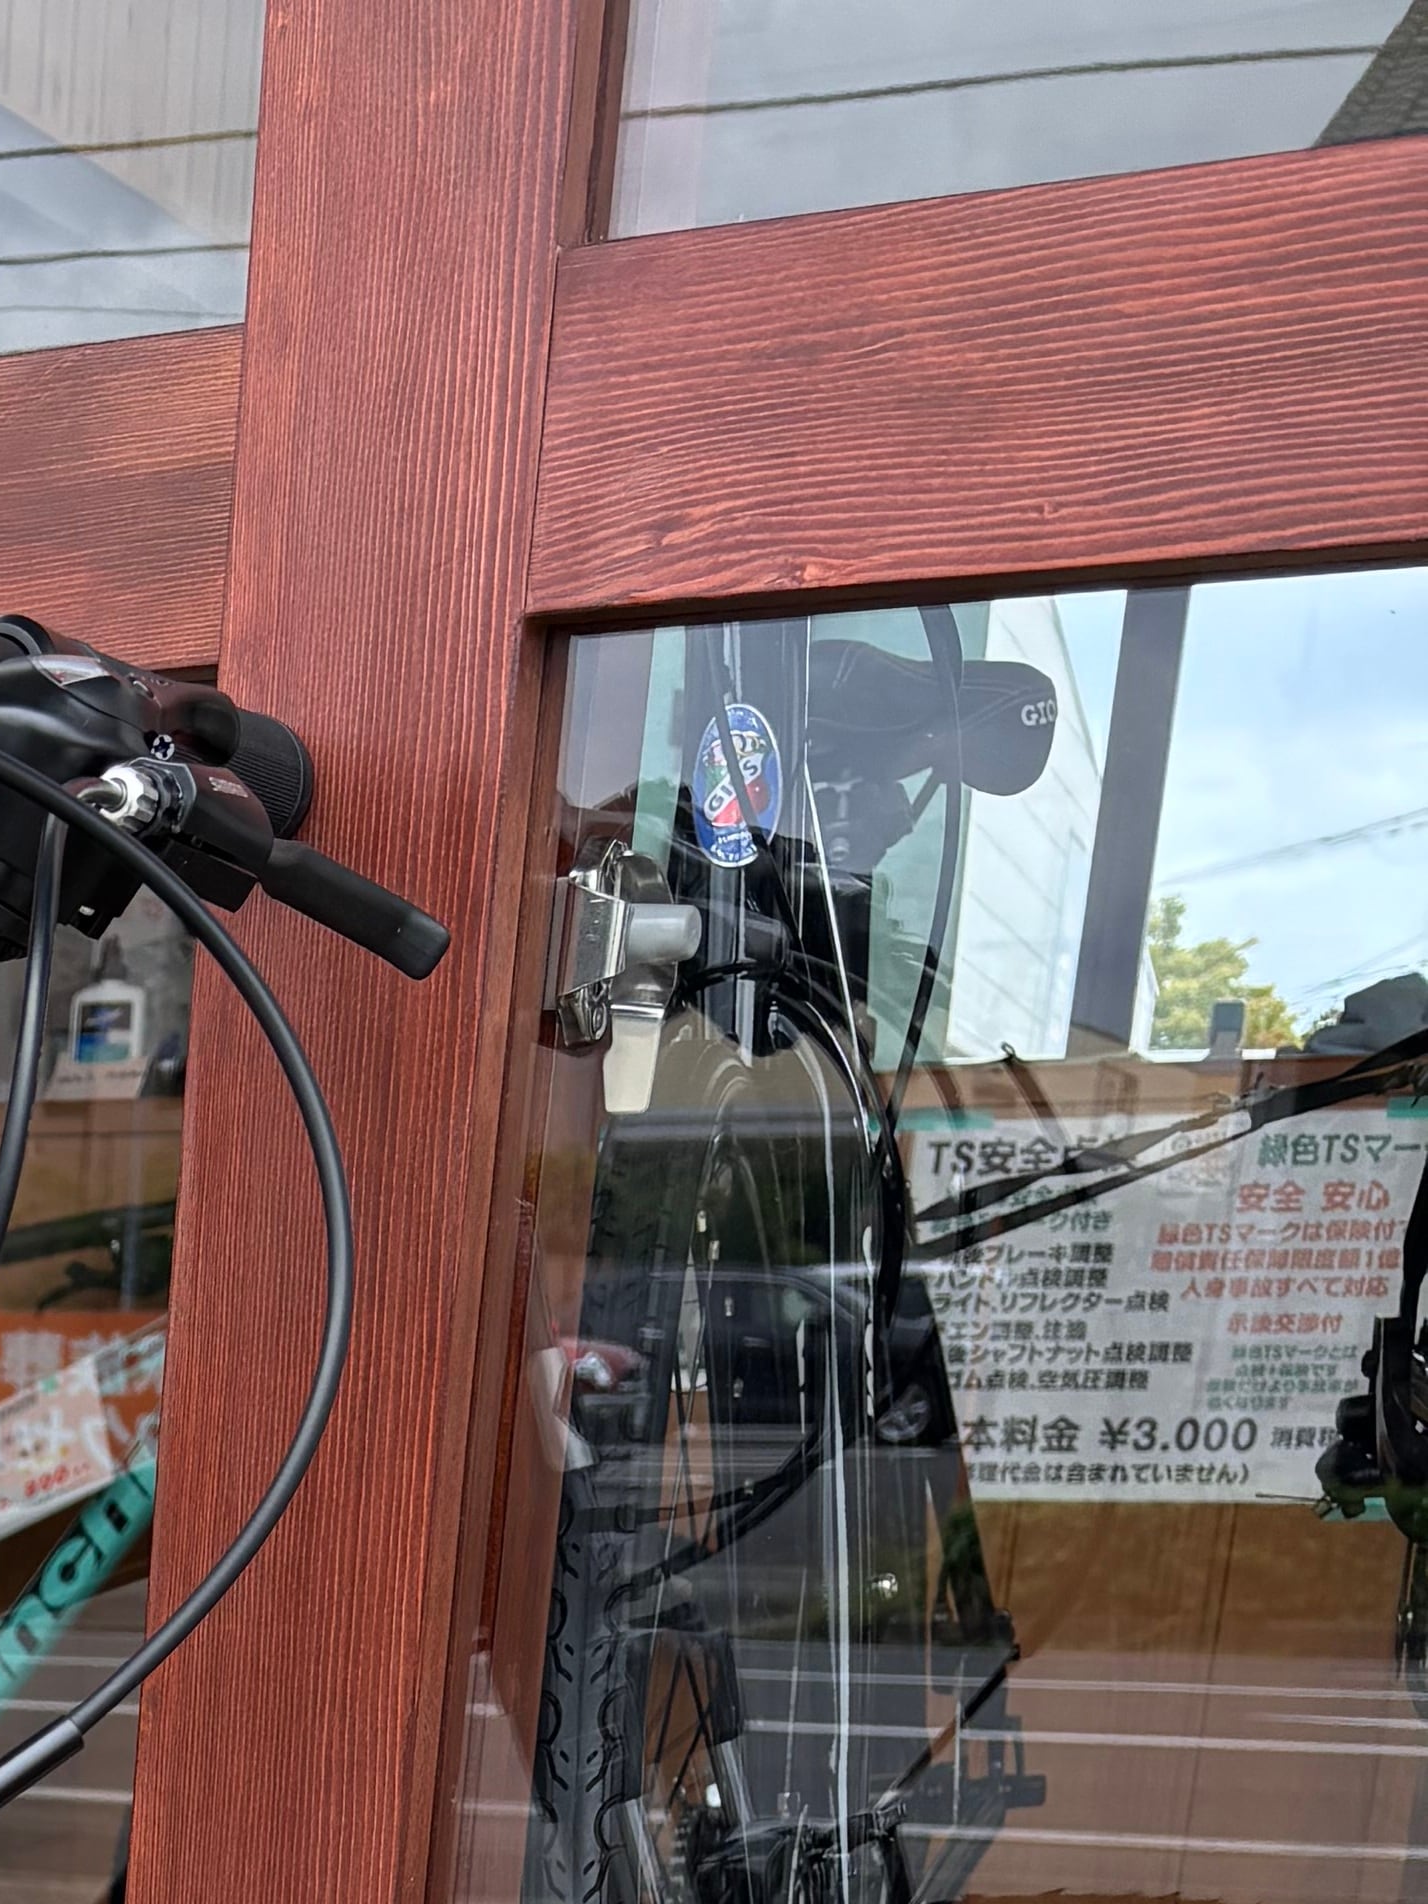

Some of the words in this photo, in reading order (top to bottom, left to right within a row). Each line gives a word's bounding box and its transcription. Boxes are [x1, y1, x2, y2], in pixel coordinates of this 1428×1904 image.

[1020, 699, 1058, 727] GIO
[707, 759, 759, 811] GIS
[1256, 1134, 1428, 1167] 緑色TSマー
[1236, 1179, 1306, 1212] 安全
[1321, 1179, 1390, 1212] 安心
[946, 1342, 1193, 1366] 後シャフトナット点検調整
[961, 1415, 1081, 1454] 本料金
[966, 1461, 1250, 1486] 理代金は含まれていません)
